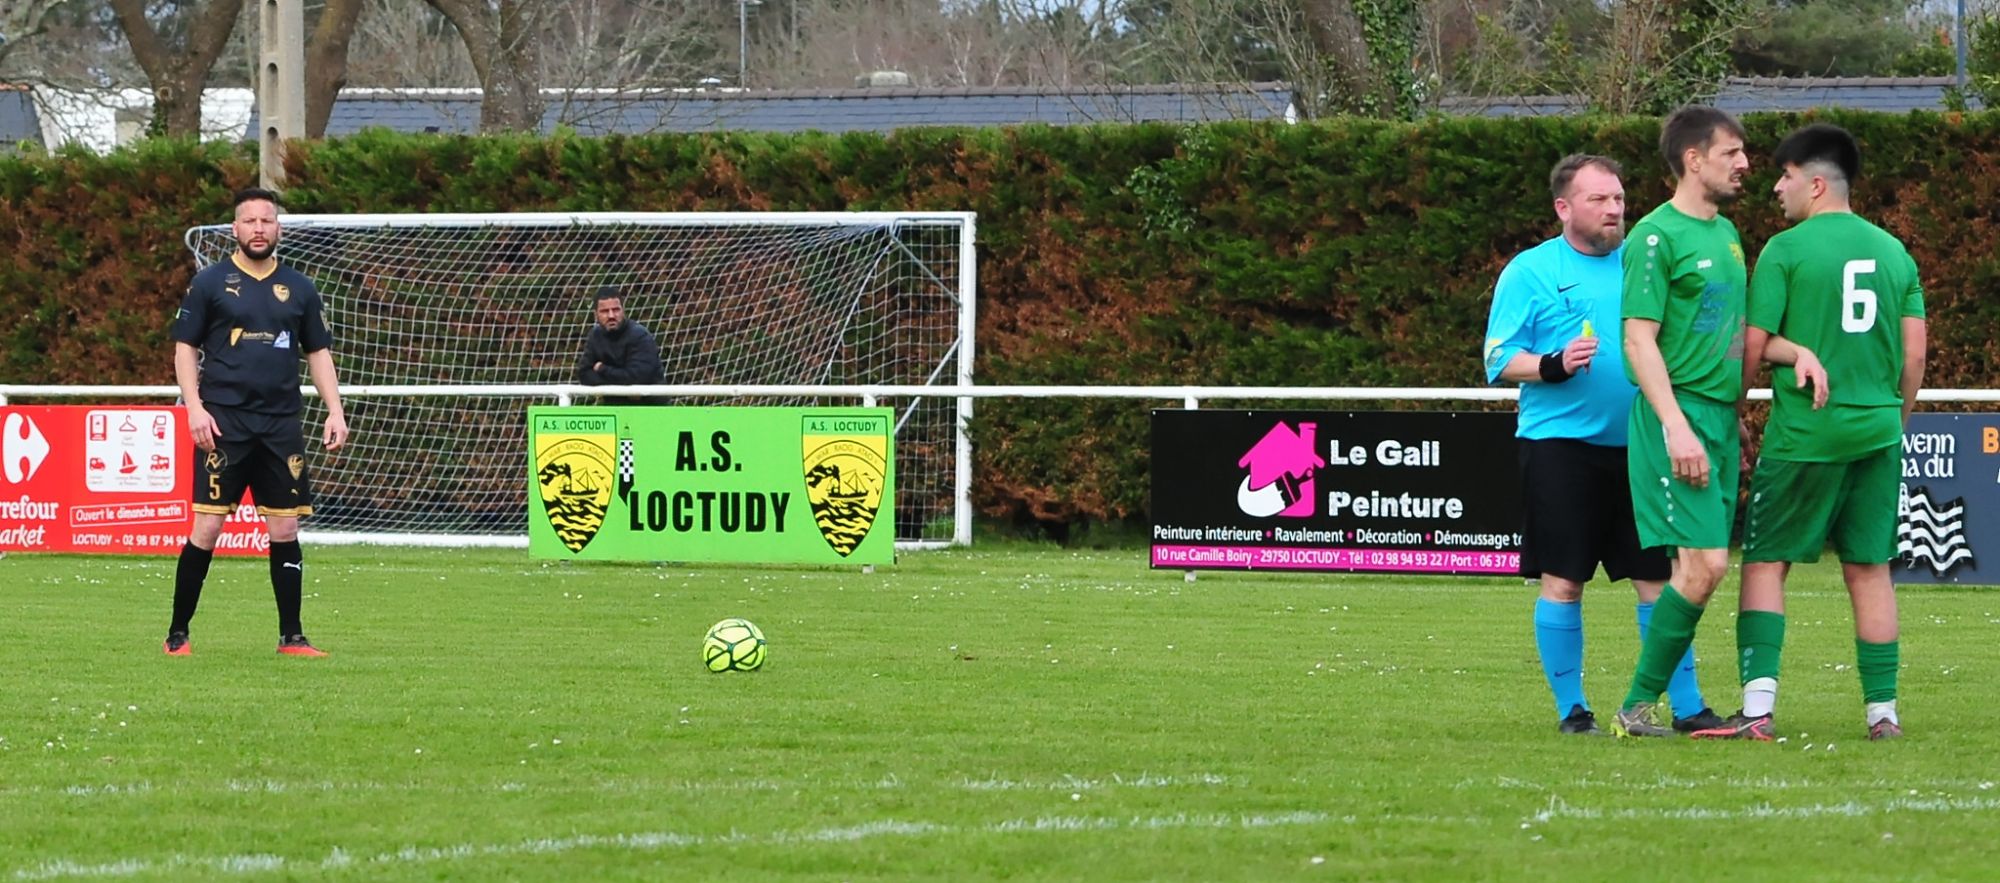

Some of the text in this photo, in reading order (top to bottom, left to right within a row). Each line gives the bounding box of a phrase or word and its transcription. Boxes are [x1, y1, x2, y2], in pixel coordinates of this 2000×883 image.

[1841, 259, 1877, 333] 6
[543, 420, 607, 430] A.S. LOCTUDY
[811, 421, 877, 431] A.S. LOCTUDY
[675, 430, 742, 472] A.S.
[1983, 426, 2000, 453] B
[1330, 439, 1440, 466] Le Gall
[1924, 453, 1954, 477] du
[210, 474, 220, 499] 5
[0, 494, 59, 519] refour
[76, 504, 182, 521] Ouvert le dimanche matin
[630, 490, 791, 533] LOCTUDY
[1328, 490, 1463, 519] Peinture
[0, 524, 46, 547] arket
[72, 534, 112, 545] LOCTUDY
[122, 534, 134, 545] 02
[136, 534, 147, 546] 98
[162, 535, 174, 546] 94
[215, 527, 270, 551] marke
[1154, 525, 1202, 541] Peinture
[1205, 525, 1263, 541] intérieure
[1275, 527, 1344, 543] Ravalement
[1356, 528, 1422, 544] Décoration
[1434, 530, 1510, 549] Démoussage
[1157, 548, 1168, 560] 10
[1170, 551, 1186, 561] rue
[1188, 548, 1225, 561] Camille
[1226, 549, 1251, 565] Boiry
[1260, 549, 1290, 562] 29750
[1292, 550, 1340, 563] LOCTUDY
[1349, 551, 1364, 564] Tél
[1371, 552, 1384, 565] 02
[1386, 553, 1398, 565] 98
[1400, 553, 1413, 566] 94
[1415, 553, 1428, 566] 93
[1430, 554, 1443, 566] 22
[1451, 554, 1472, 567] Port
[1479, 554, 1493, 567] 06
[1494, 555, 1507, 567] 37
